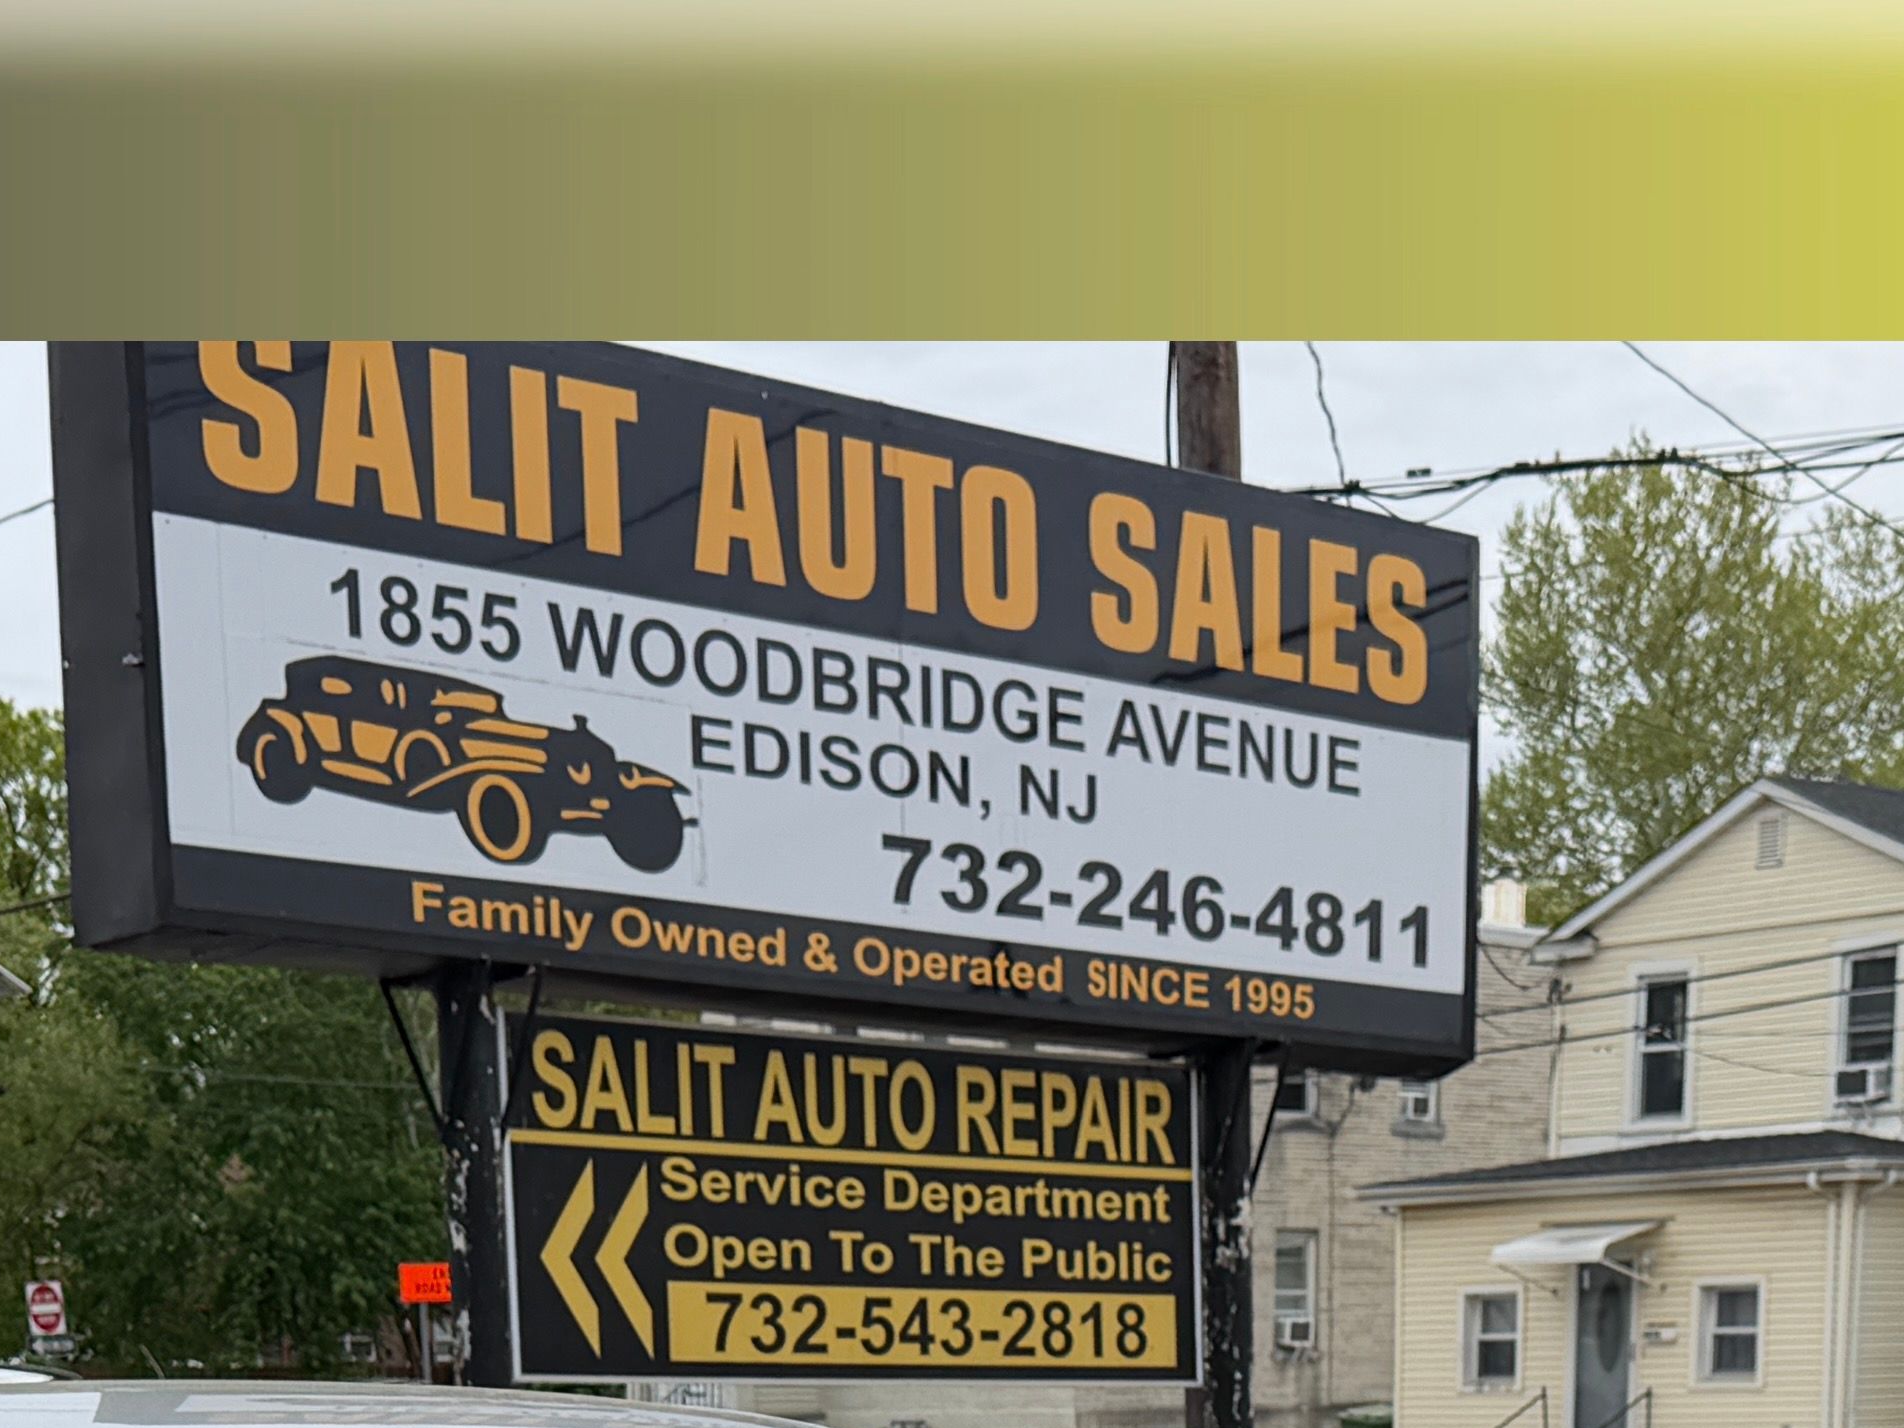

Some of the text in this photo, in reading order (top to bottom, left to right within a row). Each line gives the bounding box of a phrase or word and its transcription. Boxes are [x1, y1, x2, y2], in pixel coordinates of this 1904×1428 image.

[198, 341, 1428, 705] SALIT AUTO SALES
[329, 567, 1361, 797] 1855 WOODBRIDGE AVENUE
[690, 714, 1098, 824] EDISON, NJ
[411, 881, 1315, 1020] Family Owned & Operated SINCE 1995
[881, 833, 1431, 968] 732-246-4811
[531, 1029, 1176, 1165] SALIT AUTO REPAIR
[660, 1156, 1171, 1225] Service Department
[663, 1223, 1173, 1283] Open To The Public
[705, 1291, 1148, 1359] 732-543-2818
